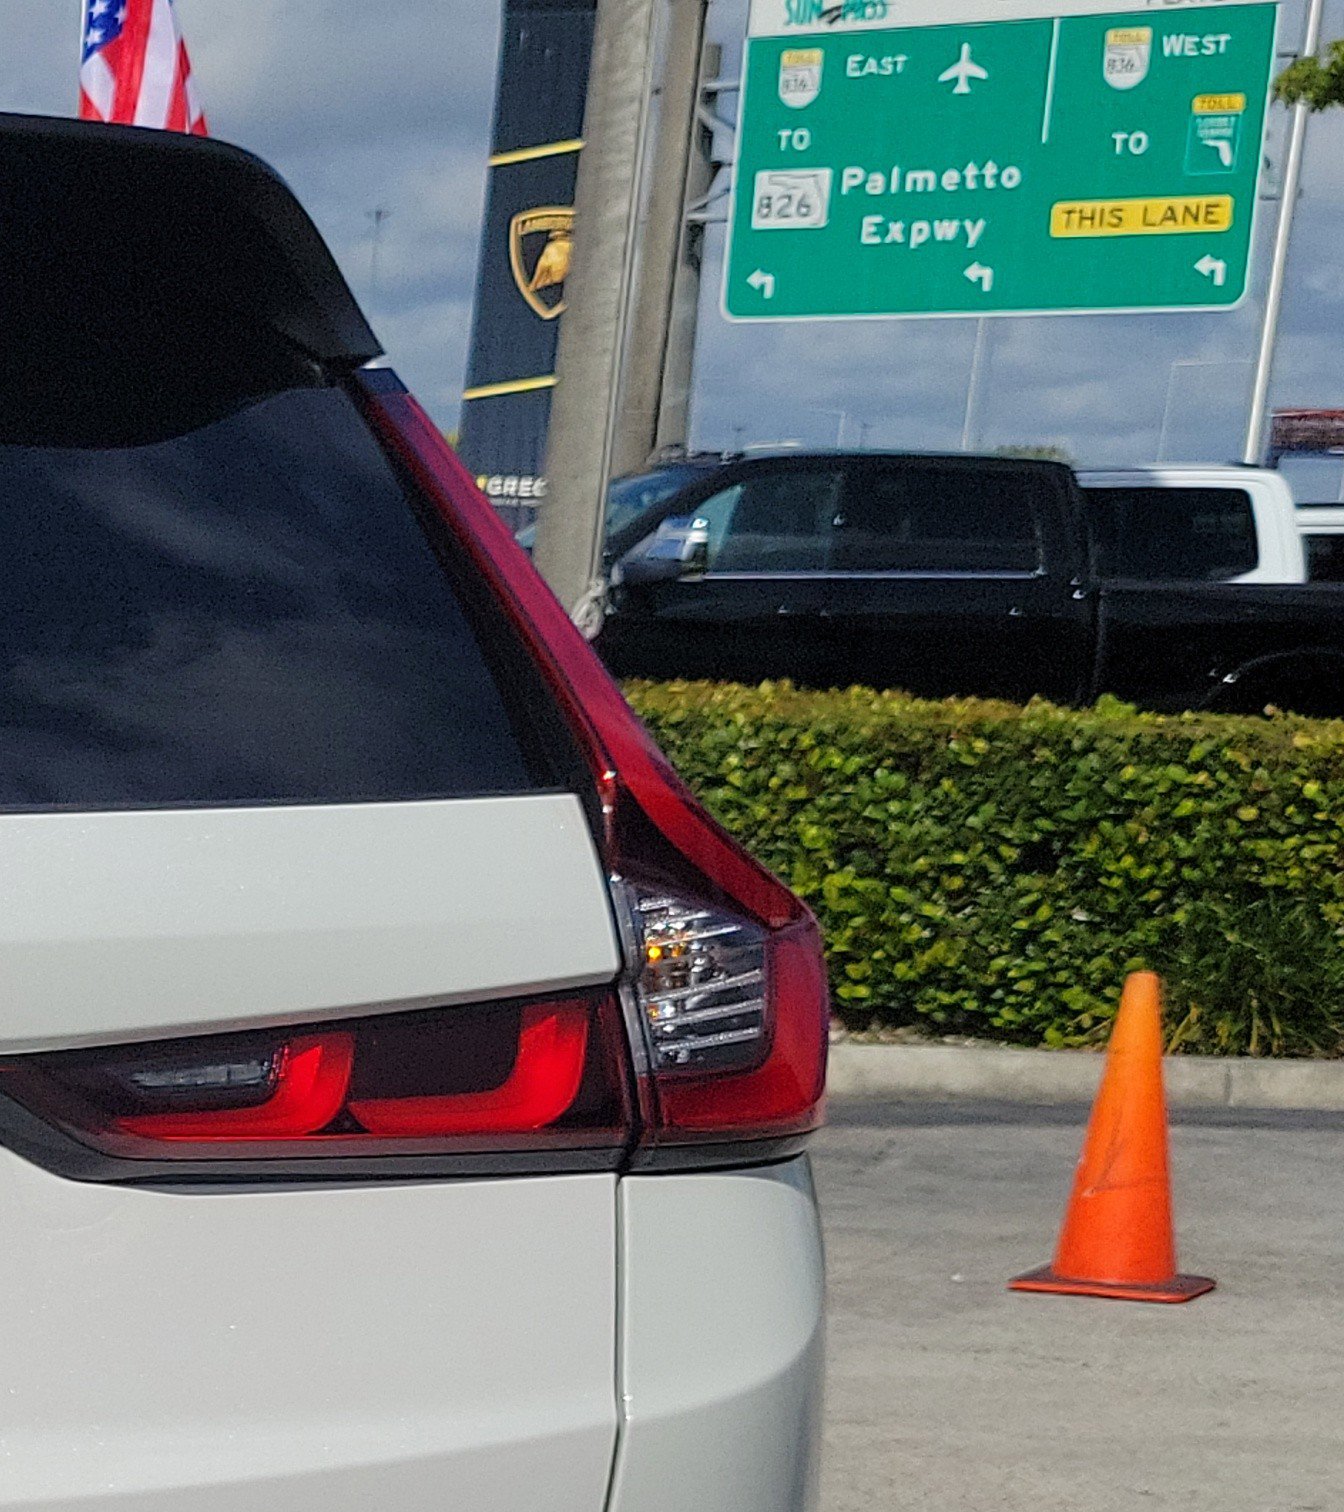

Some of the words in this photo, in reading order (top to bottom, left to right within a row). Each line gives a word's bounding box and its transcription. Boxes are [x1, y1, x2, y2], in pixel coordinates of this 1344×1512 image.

[1163, 33, 1232, 57] WEST
[846, 53, 909, 78] EAST
[777, 127, 811, 151] TO
[1112, 130, 1149, 155] TO
[841, 159, 1022, 196] Palmetto
[757, 194, 811, 219] 826
[1062, 207, 1124, 230] THIS
[1141, 202, 1221, 228] LANE
[860, 214, 987, 249] Expwy
